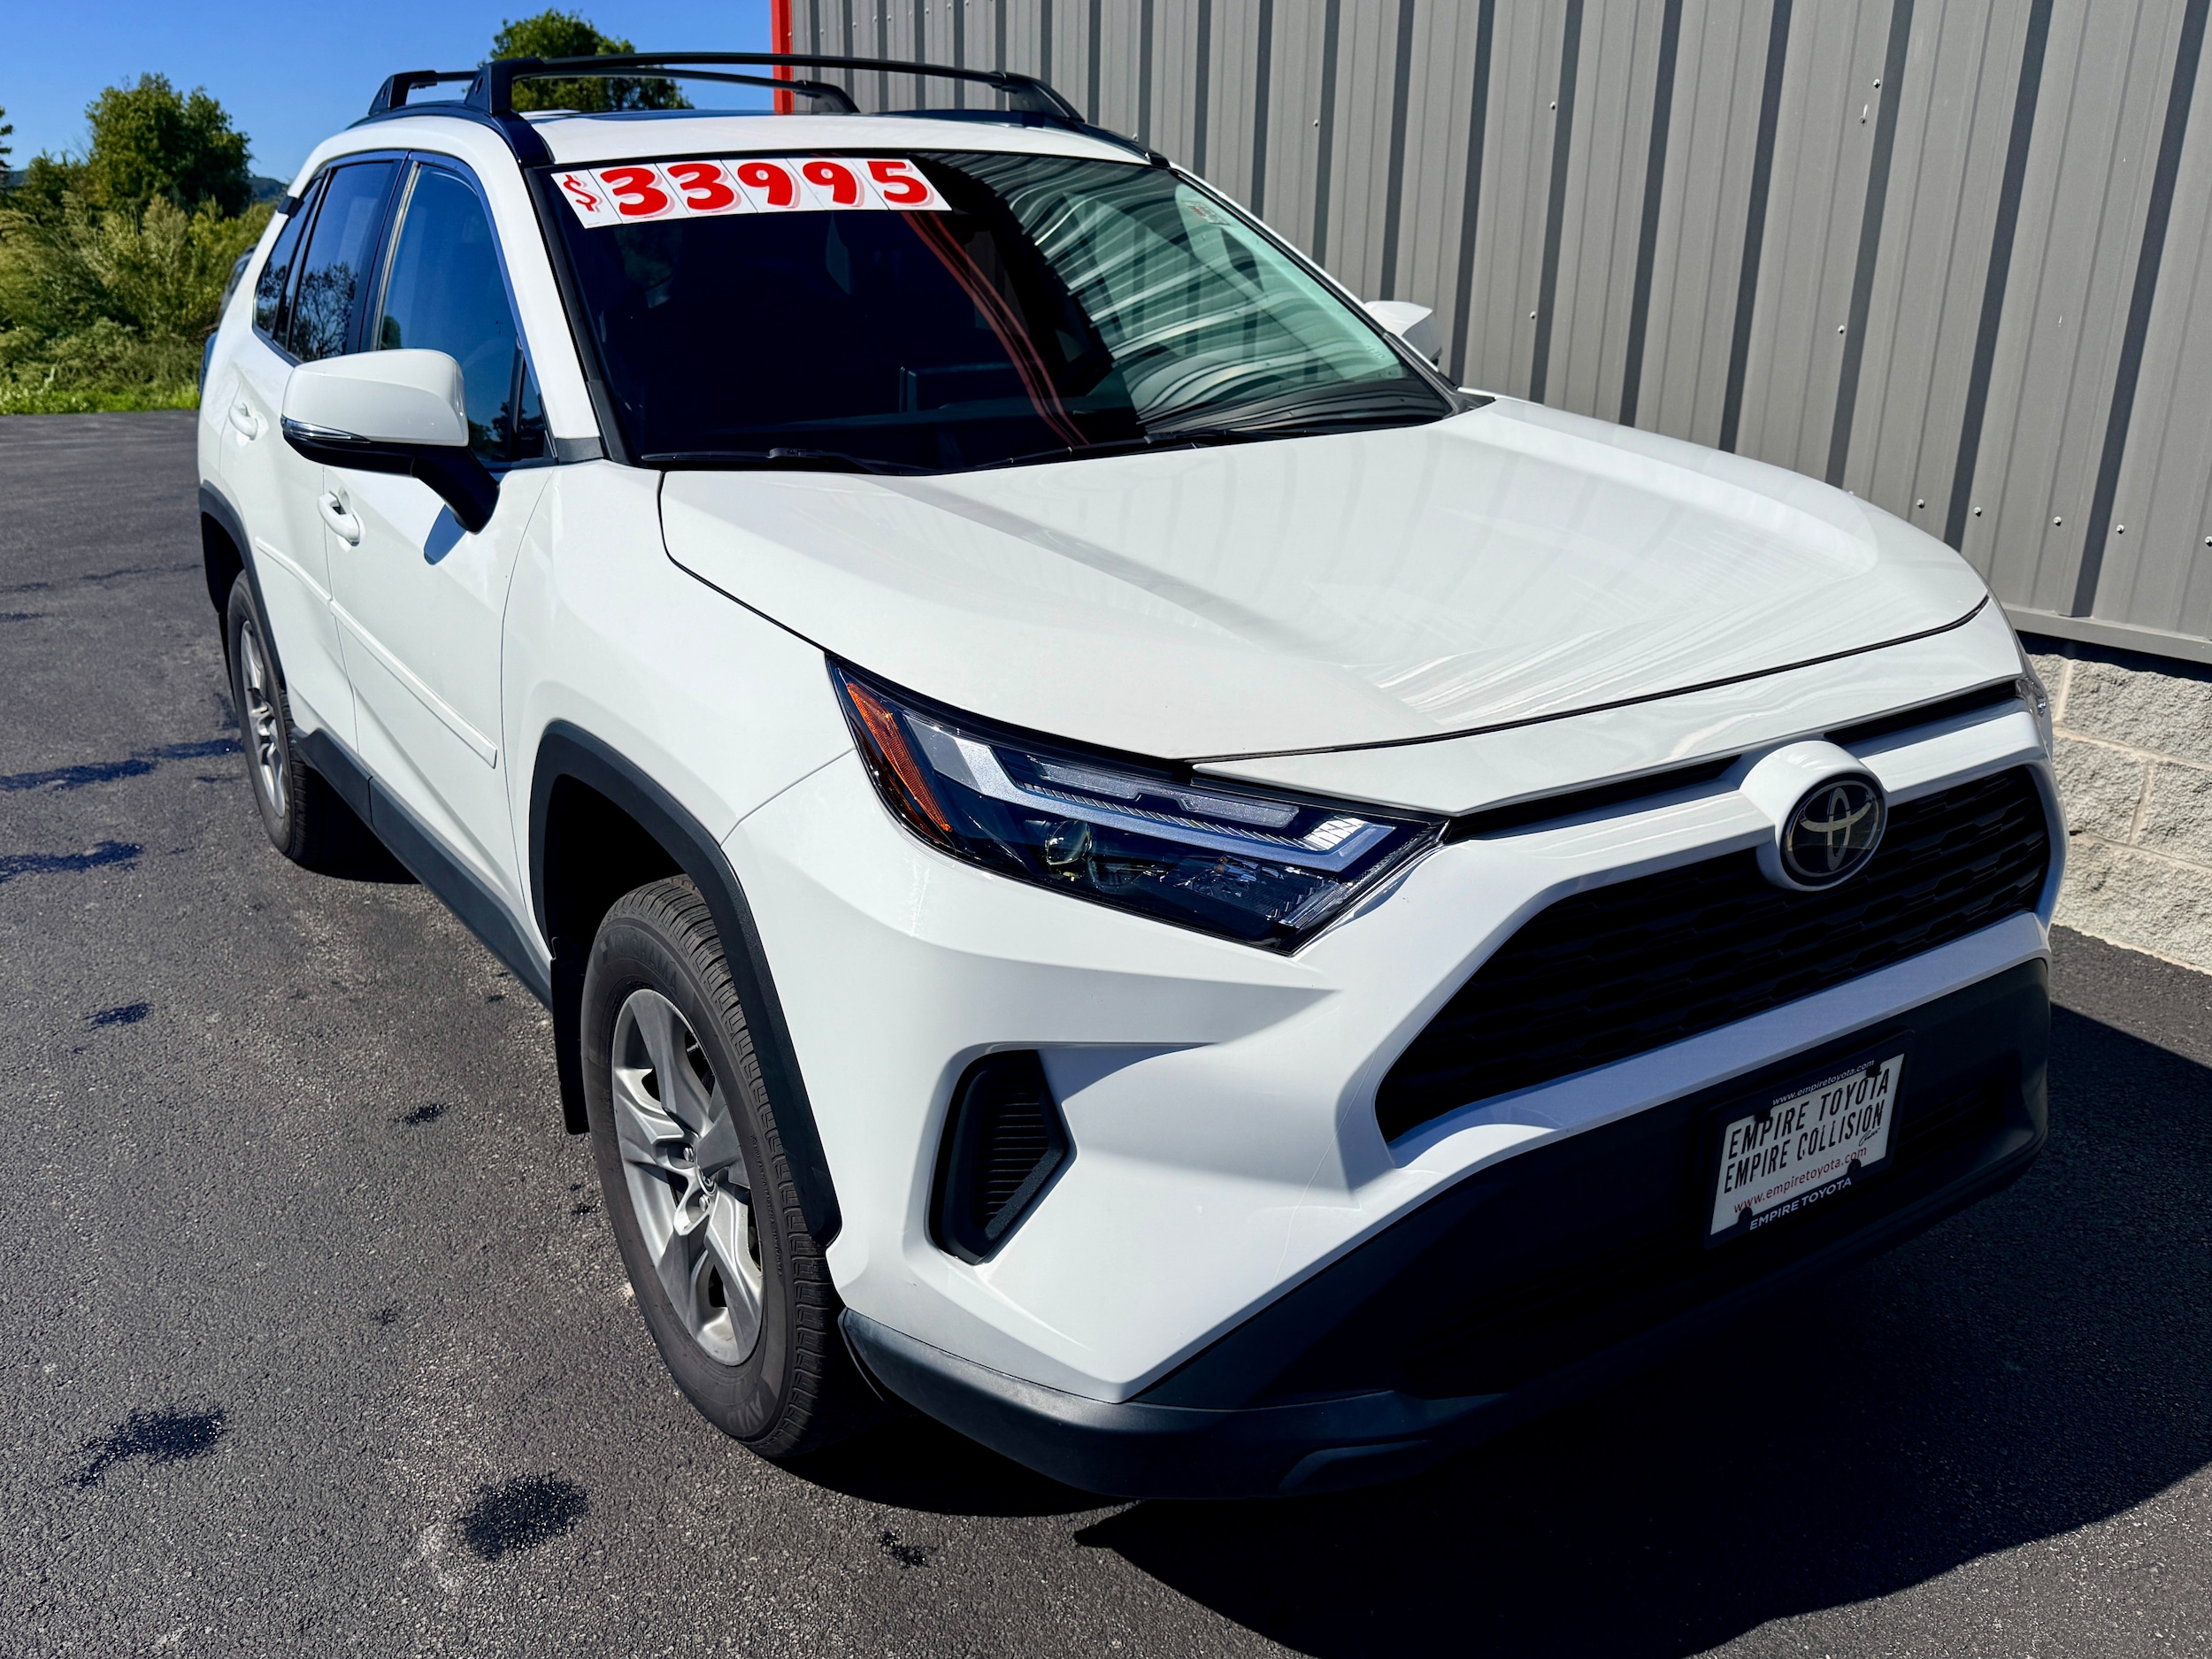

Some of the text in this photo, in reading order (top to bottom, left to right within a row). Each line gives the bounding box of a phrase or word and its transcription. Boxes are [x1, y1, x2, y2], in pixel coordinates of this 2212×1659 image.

[563, 159, 934, 217] $33995
[1728, 1068, 1890, 1160] EMPIRE TOYOTA
[1772, 1060, 1875, 1106] www.empiretoyota.com
[1724, 1100, 1886, 1194] EMPIRE COLLISION
[1733, 1147, 1867, 1214] www.empiretoyota.com
[1749, 1177, 1852, 1231] EMPIRE TOYOTA
